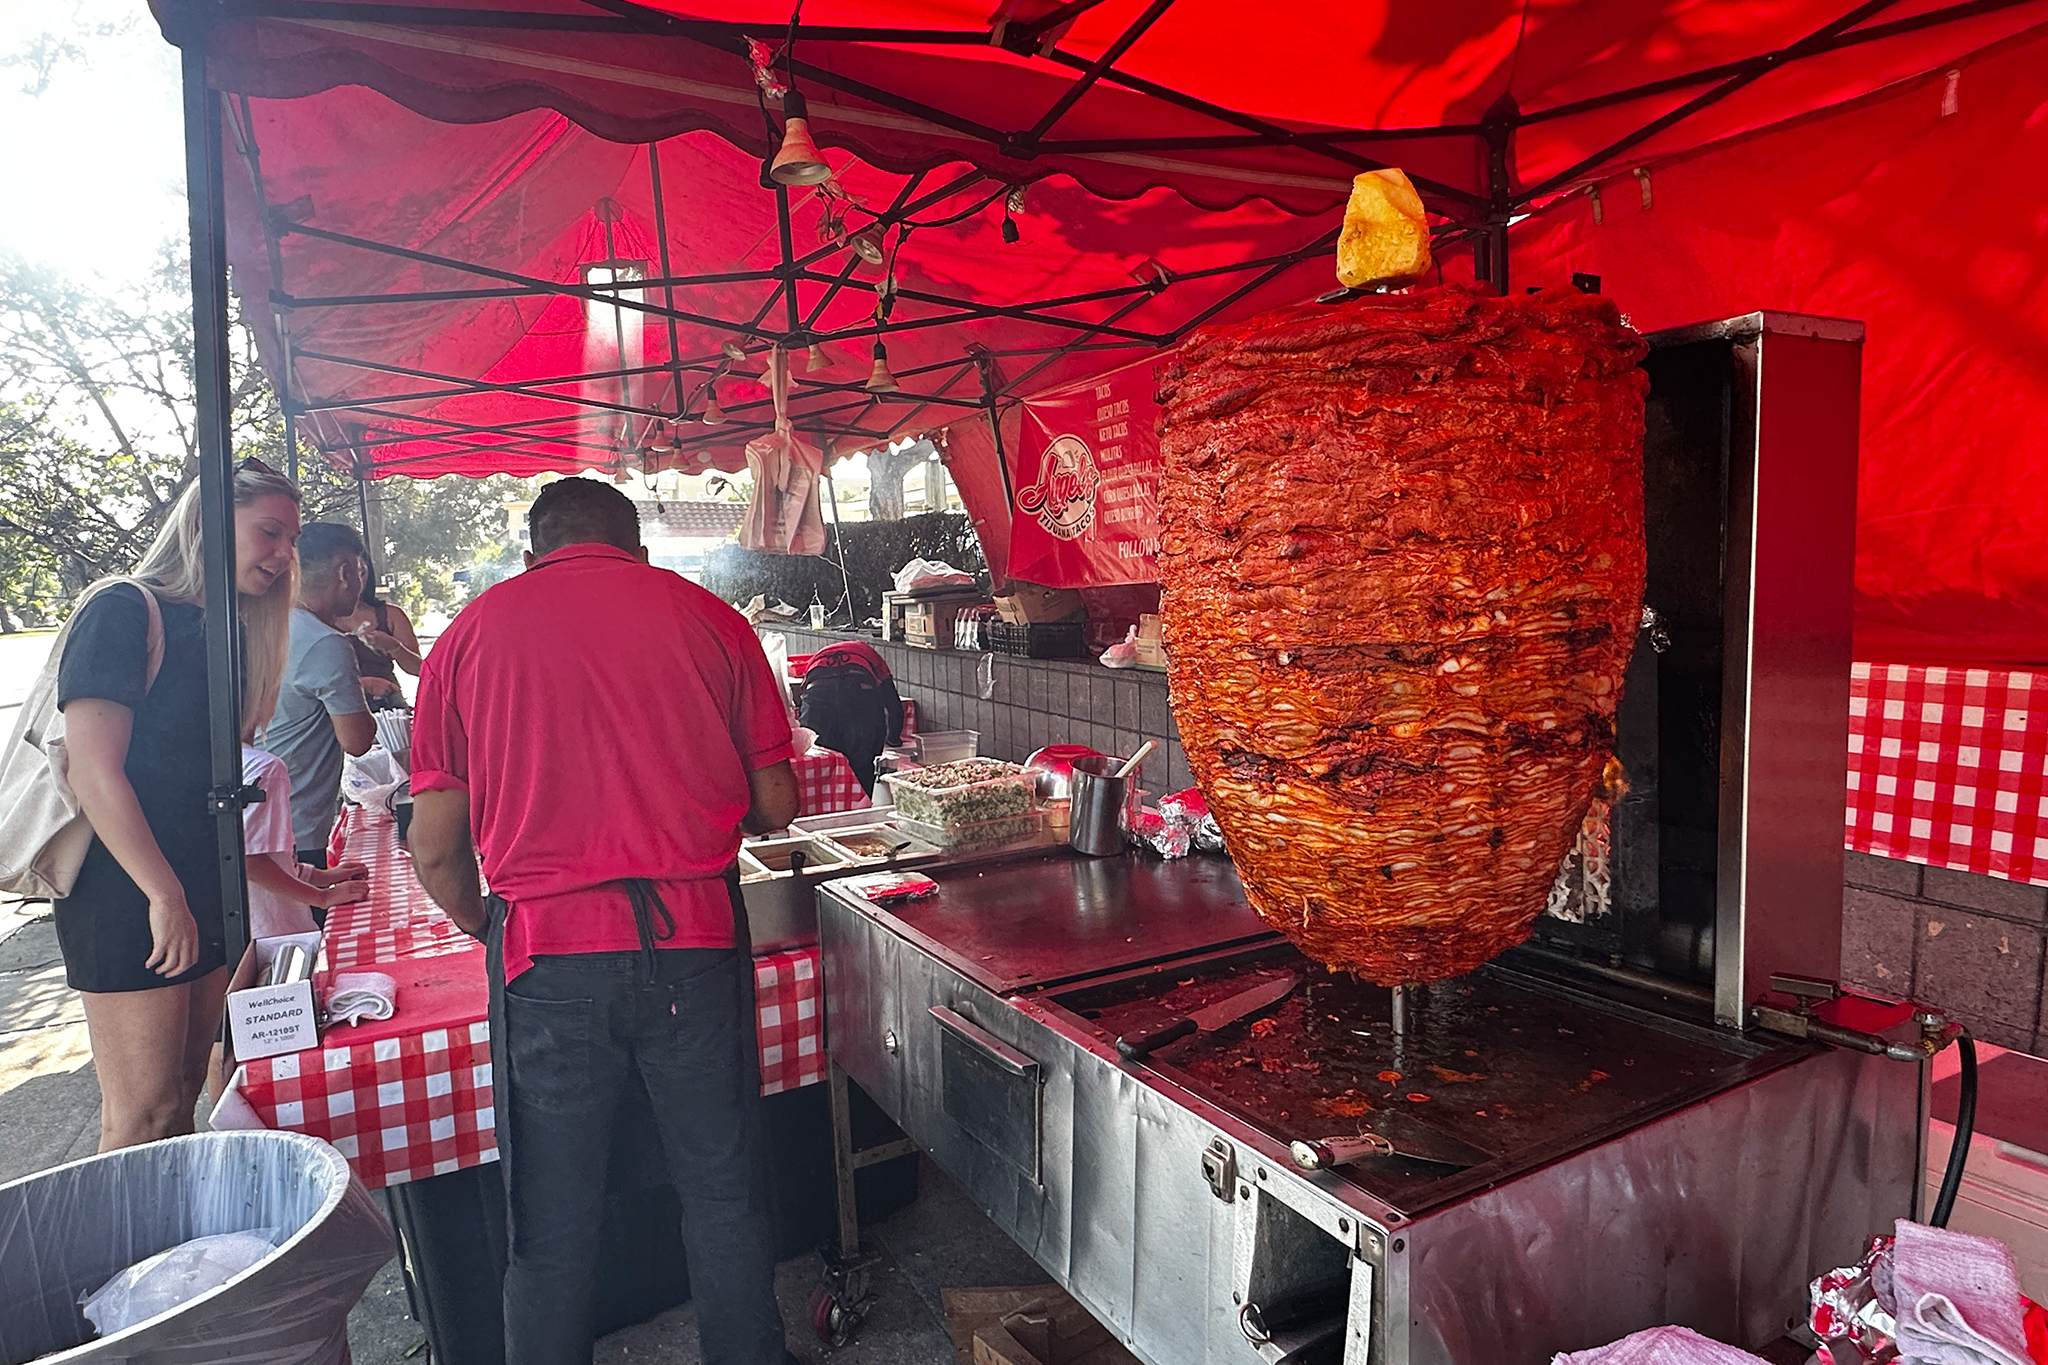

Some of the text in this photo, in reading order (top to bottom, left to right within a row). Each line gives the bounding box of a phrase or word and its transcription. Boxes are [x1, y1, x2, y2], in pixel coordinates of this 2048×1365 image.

[1095, 383, 1111, 400] TACOS
[1113, 399, 1129, 417] TACOS
[1099, 421, 1128, 442] KETO TACOS
[1100, 445, 1122, 462] MULITAS
[1039, 507, 1095, 538] TIJUANA TACOS
[1118, 539, 1153, 559] FOLLOW
[248, 996, 295, 1009] WellChoice
[245, 1008, 303, 1025] STANDARD
[251, 1024, 300, 1040] AR-1210ST
